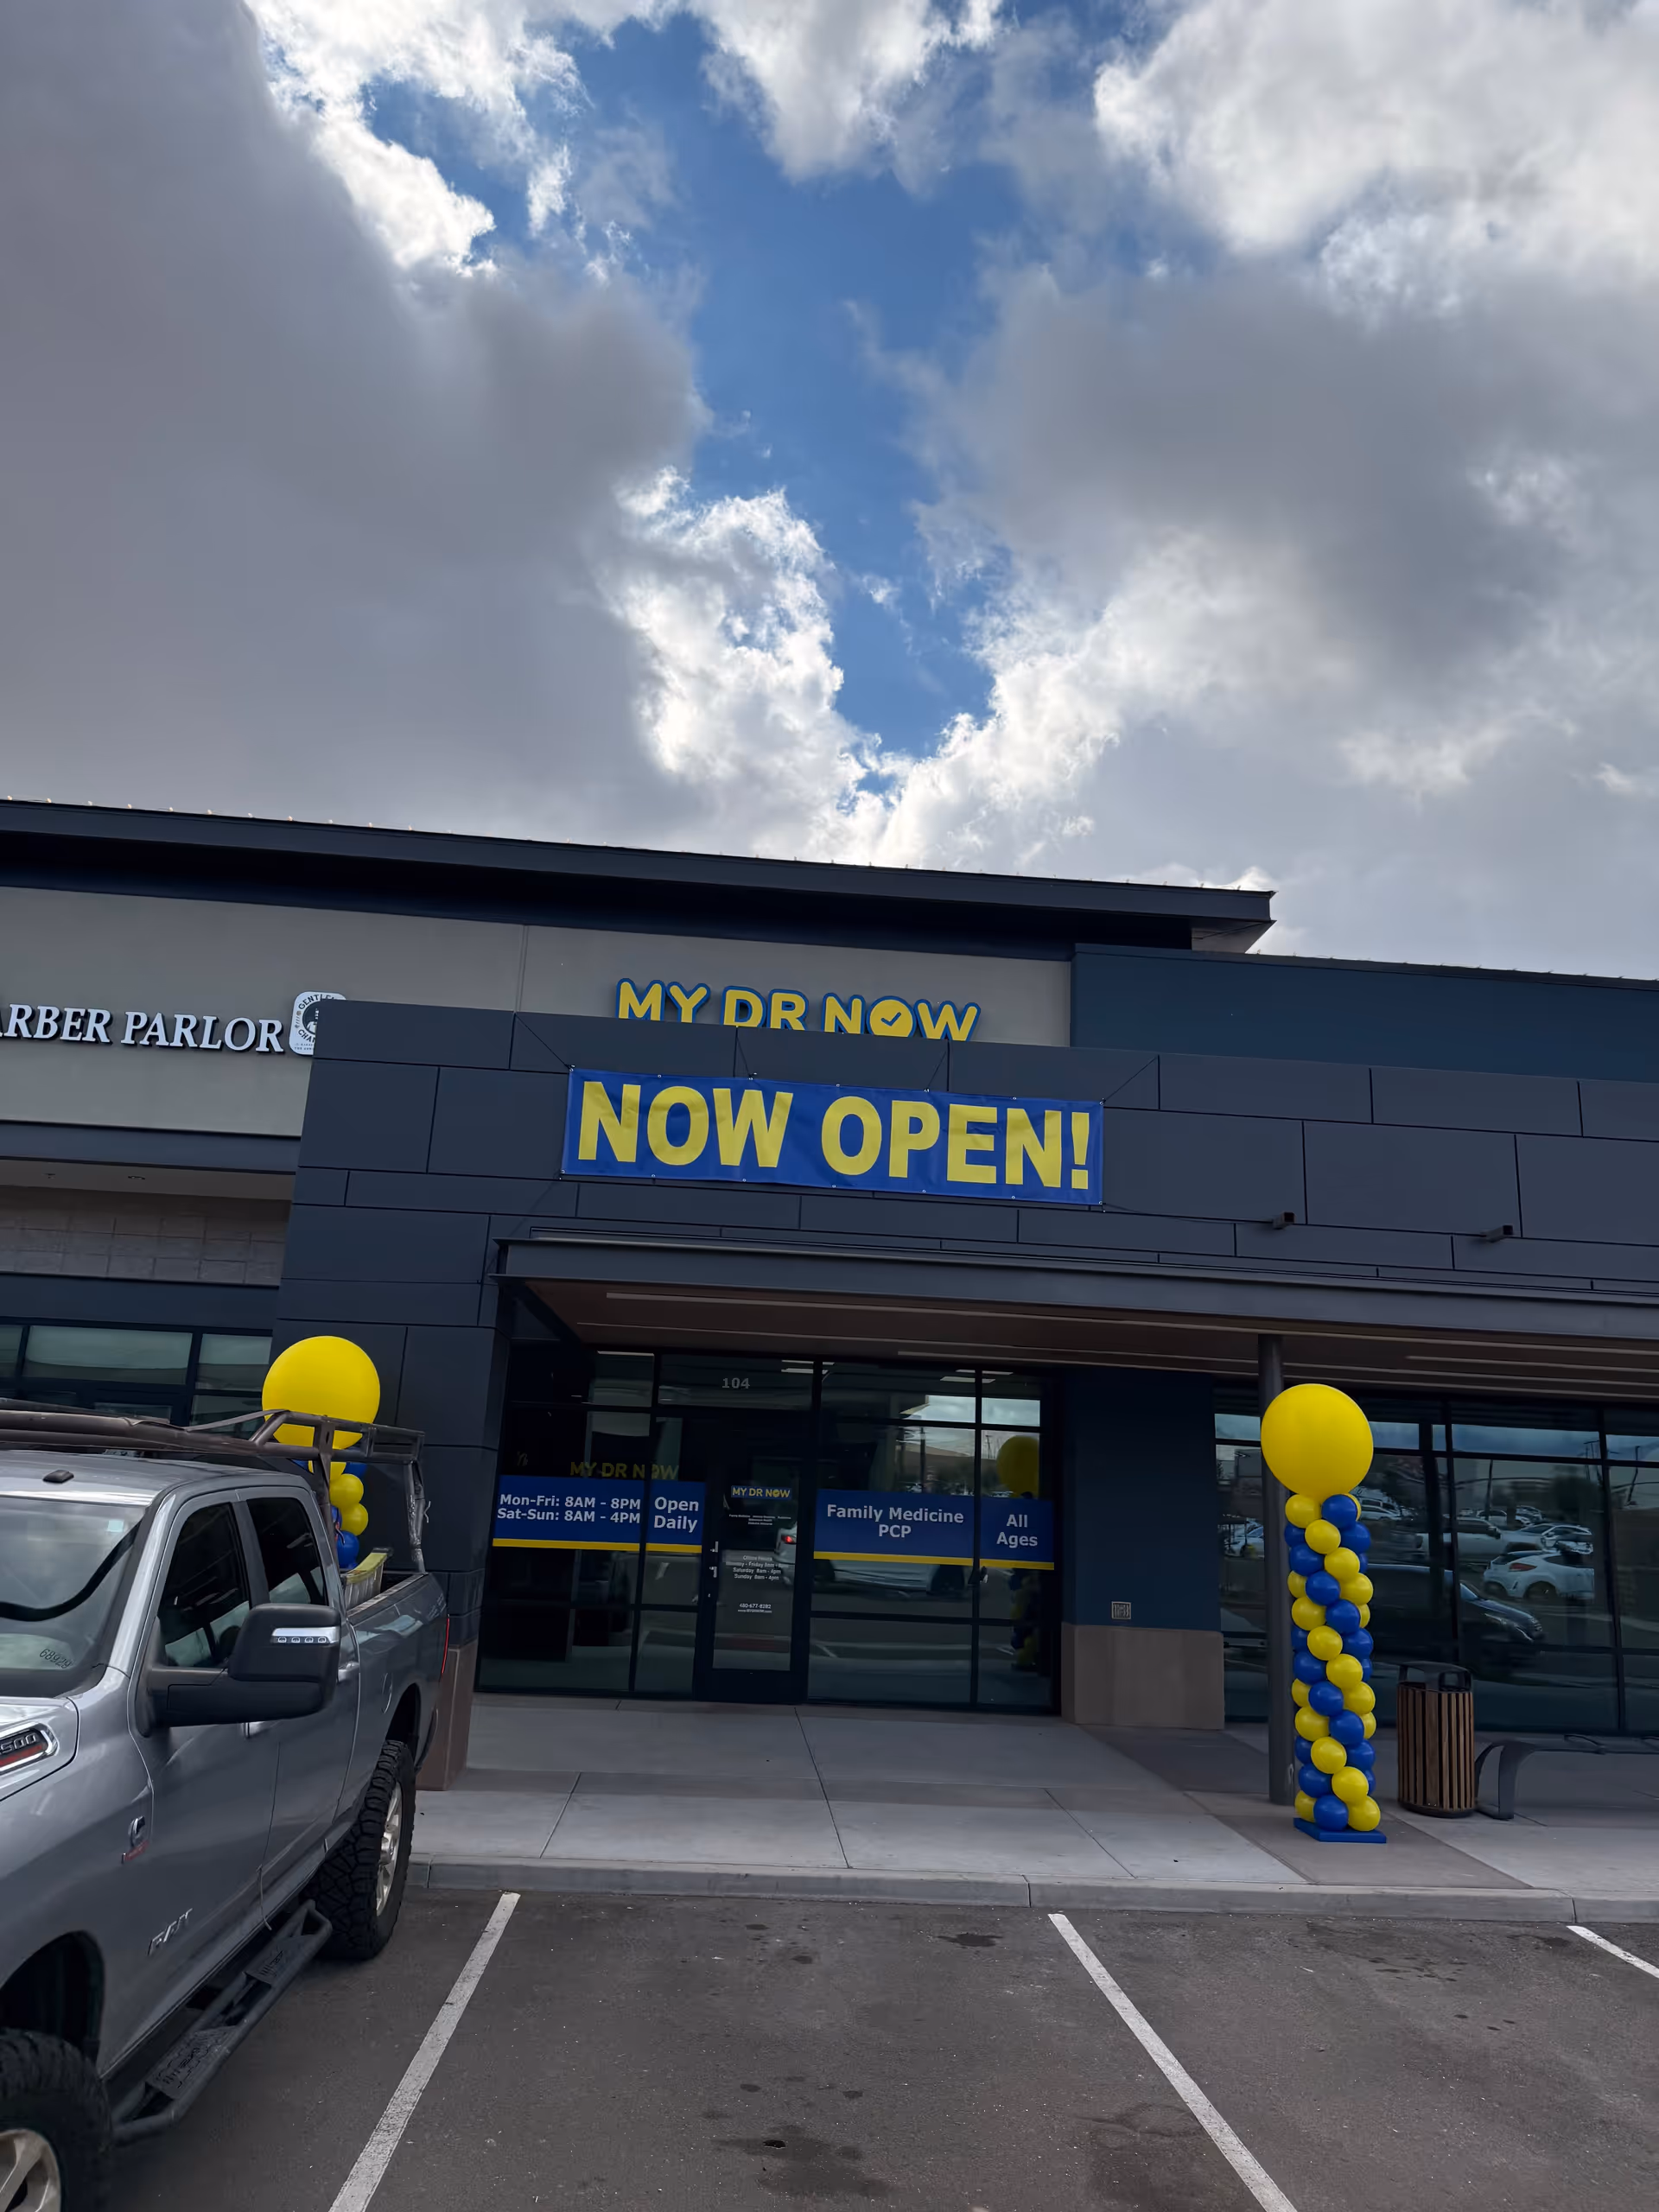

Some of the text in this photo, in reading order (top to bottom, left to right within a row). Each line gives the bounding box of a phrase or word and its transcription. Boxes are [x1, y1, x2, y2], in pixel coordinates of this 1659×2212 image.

[617, 978, 981, 1041] MY DR NOW
[0, 1002, 284, 1053] RBER PARLOR
[577, 1080, 1090, 1190] NOW OPEN!
[721, 1377, 750, 1389] 104
[570, 1461, 597, 1478] MY
[601, 1462, 627, 1478] DR
[732, 1487, 791, 1498] MY DR NOW
[499, 1494, 560, 1507] Mon-Fri:
[564, 1497, 595, 1508] 8AM
[610, 1497, 641, 1510] 8PM
[654, 1497, 699, 1513] Open
[497, 1508, 559, 1521] Sat-Sun:
[564, 1510, 595, 1522] 8AM
[610, 1512, 640, 1523] 4PM
[827, 1504, 964, 1523] Family Medicine
[1007, 1514, 1028, 1528] All
[653, 1515, 697, 1533] Daily
[878, 1524, 912, 1538] PCP
[996, 1532, 1038, 1548] Ages
[0, 1732, 36, 1755] 500
